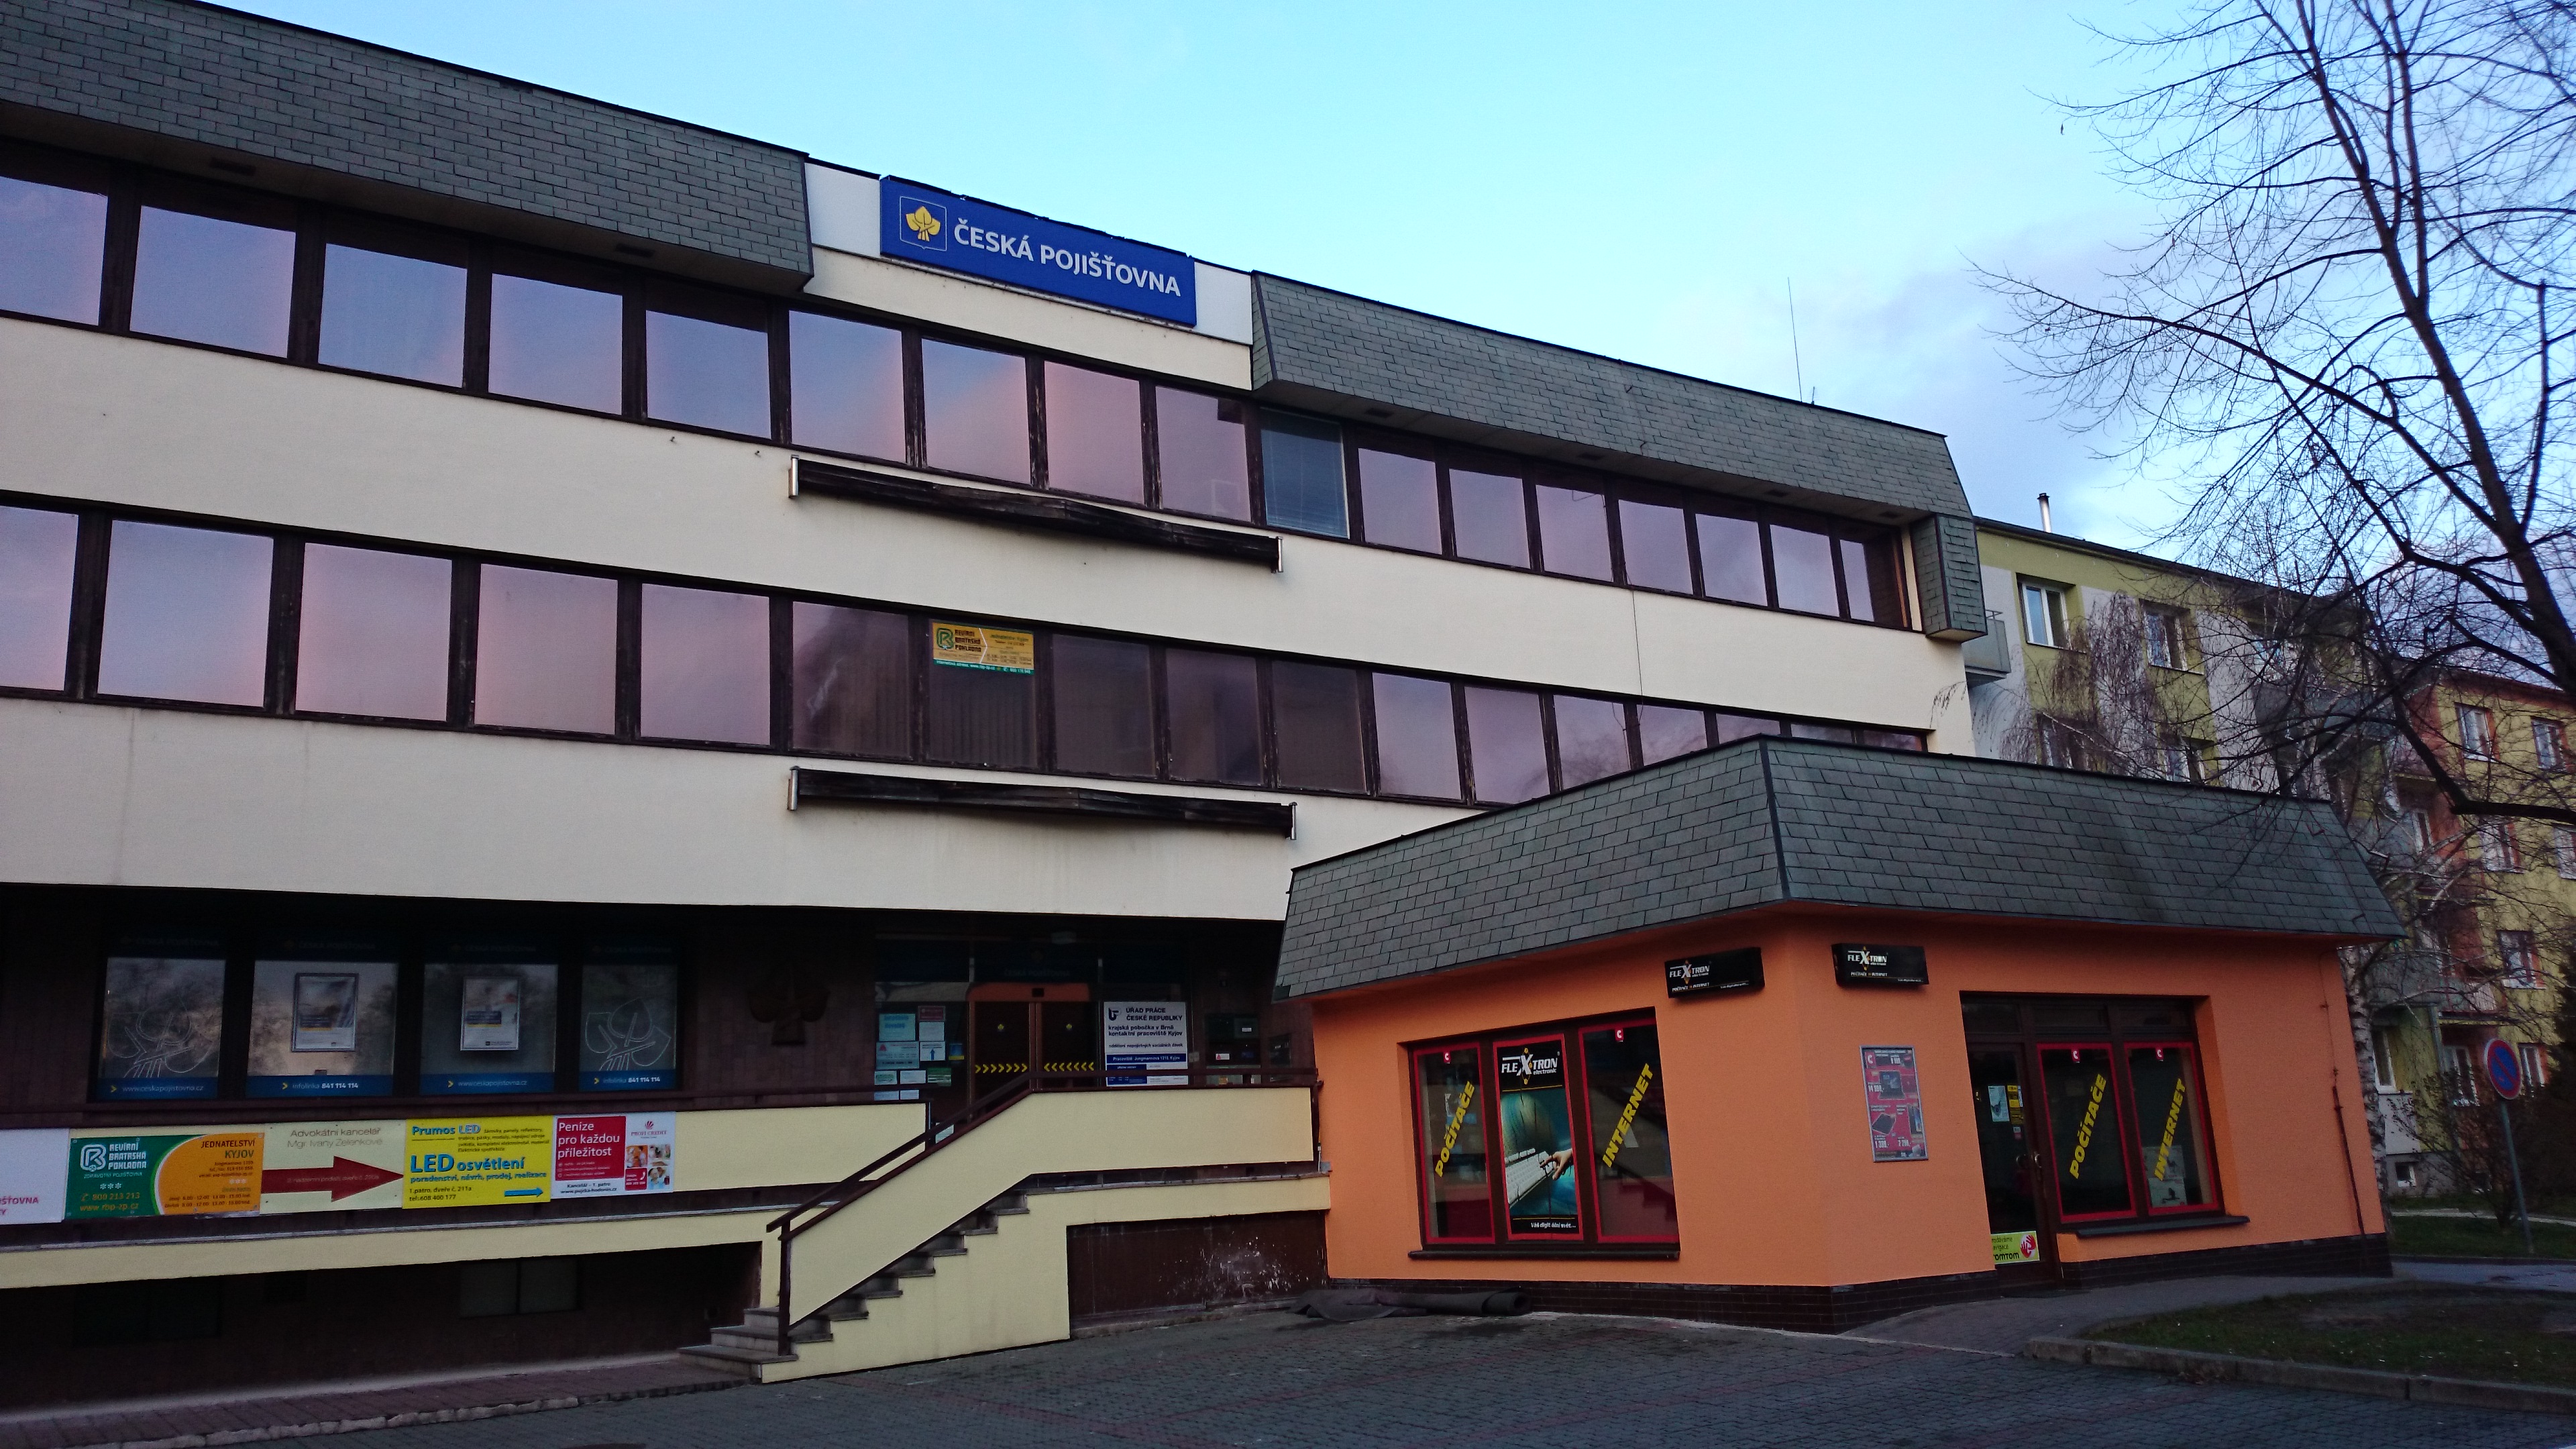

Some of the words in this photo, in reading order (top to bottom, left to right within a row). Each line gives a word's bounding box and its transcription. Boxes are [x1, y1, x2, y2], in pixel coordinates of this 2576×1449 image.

[954, 217, 1034, 262] ČESKÁ
[1040, 244, 1181, 297] POJIŠŤOVNA
[1847, 951, 1887, 965] FLEXTRON
[1669, 964, 1710, 979] FLEXTRON
[1501, 1054, 1558, 1076] FLEXTRON
[1602, 1063, 1654, 1169] INTERNET
[290, 1128, 339, 1137] Advokátní
[340, 1126, 382, 1136] kancelář
[411, 1126, 455, 1136] Prumos
[458, 1124, 481, 1134] LED
[558, 1121, 594, 1132] Peníze
[1434, 1080, 1476, 1178] POČÍTAČE
[2069, 1073, 2107, 1179] POČÍTAČE
[2154, 1078, 2187, 1181] INTERNET
[201, 1139, 256, 1148] JEDNATELSTVÍ
[310, 1139, 333, 1148] Ivany
[335, 1138, 383, 1146] Zelenkové
[558, 1136, 578, 1147] pro
[580, 1133, 620, 1144] každou
[109, 1151, 147, 1161] BRATRSKÁ
[225, 1149, 254, 1159] KYJOV
[557, 1146, 612, 1161] příležitost
[108, 1161, 147, 1170] POKLADNA
[410, 1154, 455, 1173] LED
[457, 1157, 526, 1171] osvětlení
[461, 1173, 485, 1181] návrh,
[486, 1173, 513, 1181] prodej,
